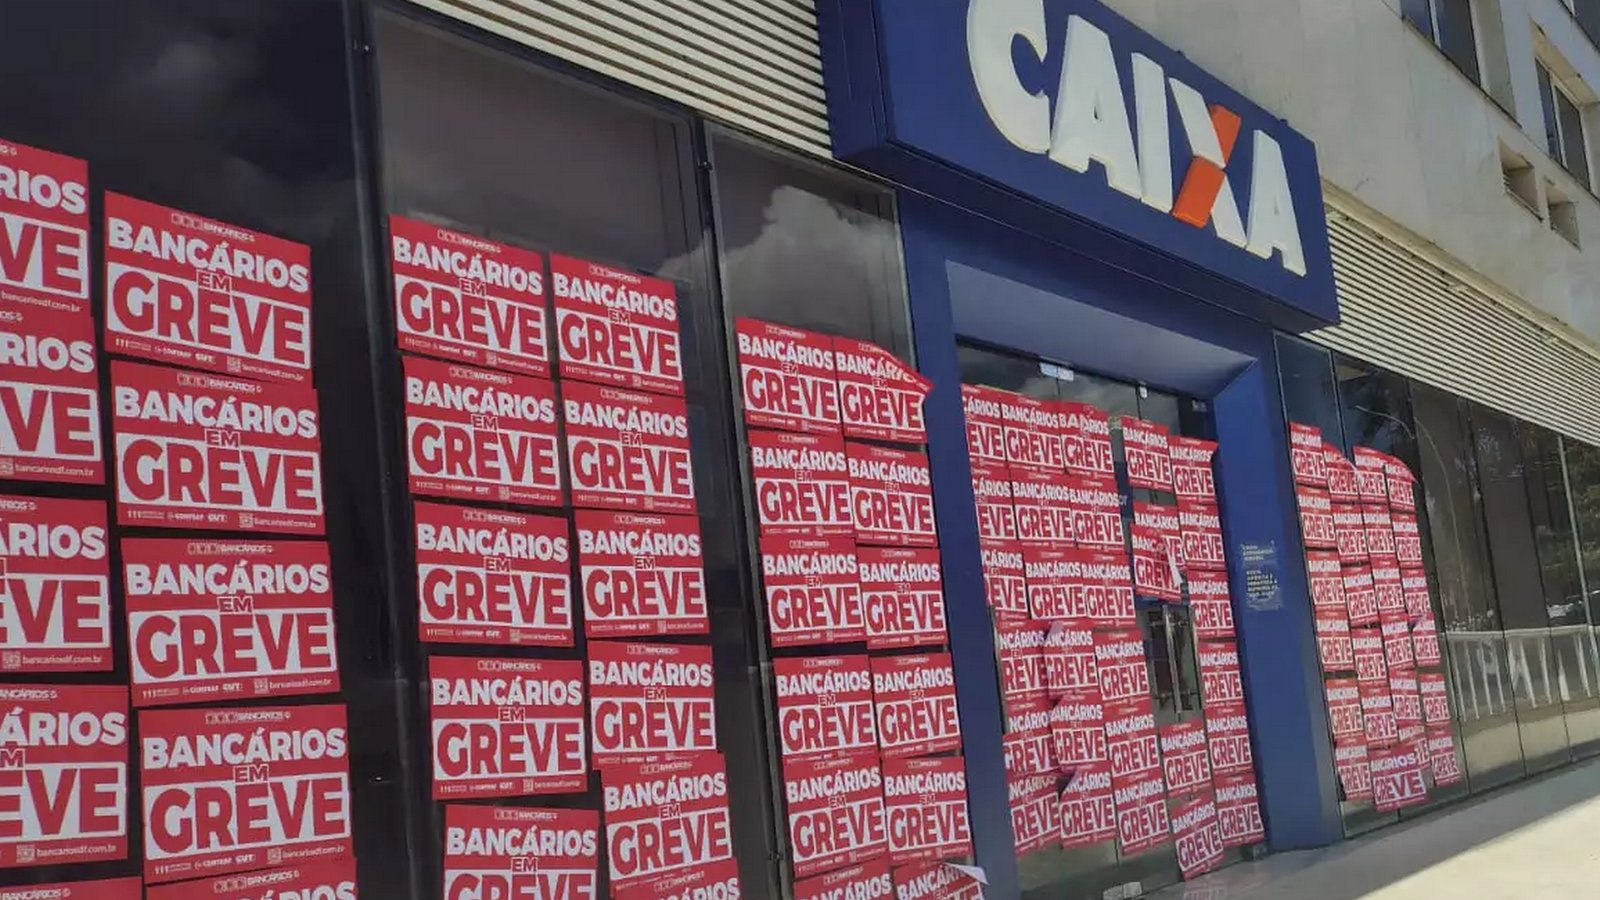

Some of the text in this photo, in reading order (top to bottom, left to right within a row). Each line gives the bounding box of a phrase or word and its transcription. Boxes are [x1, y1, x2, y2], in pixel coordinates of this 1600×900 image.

[966, 0, 1306, 277] CAIXA
[108, 216, 309, 291] BANCÁRIOS
[393, 239, 543, 296] BANCÁRIOS
[196, 270, 231, 294] EM
[459, 280, 484, 299] EM
[554, 273, 676, 320] BANCÁRIOS
[113, 273, 304, 362] GREVE
[400, 284, 542, 356] GREVE
[608, 309, 630, 326] EM
[561, 315, 678, 376] GREVE
[739, 334, 836, 370] BANCÁRIOS
[115, 387, 319, 436] BANCÁRIOS
[406, 380, 556, 424] BANCÁRIOS
[745, 370, 837, 420] GREVE
[842, 385, 923, 428] GREVE
[472, 416, 499, 432] EM
[565, 400, 687, 438] BANCÁRIOS
[1003, 408, 1059, 429] BANCÁRIOS
[204, 429, 239, 448] EM
[412, 424, 557, 484] GREVE
[620, 432, 642, 447] EM
[1007, 431, 1061, 468] GREVE
[122, 440, 317, 509] GREVE
[572, 441, 689, 494] GREVE
[753, 449, 846, 473] BANCÁRIOS
[849, 459, 930, 486] BANCÁRIOS
[1128, 449, 1170, 482] GREVE
[761, 482, 850, 522] GREVE
[1011, 479, 1070, 500] BANCÁRIOS
[854, 491, 933, 531] GREVE
[1017, 506, 1072, 539] GREVE
[1075, 512, 1123, 542] GREVE
[417, 527, 567, 561] BANCÁRIOS
[580, 528, 701, 555] BANCÁRIOS
[126, 560, 329, 595] BANCÁRIOS
[481, 558, 507, 574] EM
[632, 557, 654, 570] EM
[764, 553, 857, 577] BANCÁRIOS
[859, 561, 941, 582] BANCÁRIOS
[1026, 560, 1082, 577] BANCÁRIOS
[0, 578, 103, 643] VE
[217, 597, 253, 614] EM
[423, 569, 567, 624] GREVE
[586, 570, 703, 617] GREVE
[771, 587, 860, 629] GREVE
[1032, 586, 1086, 617] GREVE
[1087, 588, 1135, 616] GREVE
[866, 594, 945, 632] GREVE
[136, 612, 331, 678] GREVE
[432, 676, 583, 705] BANCÁRIOS
[590, 660, 710, 687] BANCÁRIOS
[777, 670, 872, 697] BANCÁRIOS
[874, 670, 953, 696] BANCÁRIOS
[1102, 665, 1147, 697] GREVE
[643, 688, 664, 701] EM
[497, 707, 523, 722] EM
[595, 701, 712, 749] GREVE
[783, 704, 874, 751] GREVE
[880, 699, 957, 743] GREVE
[142, 729, 344, 771] BANCÁRIOS
[437, 722, 581, 775] GREVE
[1056, 730, 1106, 762] GREVE
[1112, 738, 1158, 775] GREVE
[232, 766, 267, 785] EM
[785, 769, 882, 802] BANCÁRIOS
[886, 774, 964, 799] BANCÁRIOS
[1167, 753, 1209, 788] GREVE
[603, 774, 726, 812] BANCÁRIOS
[150, 778, 344, 852] GREVE
[658, 805, 679, 820] EM
[794, 802, 884, 857] GREVE
[890, 804, 968, 847] GREVE
[1062, 797, 1114, 835] GREVE
[1121, 803, 1167, 842] GREVE
[444, 827, 594, 857] BANCÁRIOS
[611, 812, 728, 874] GREVE
[1179, 824, 1222, 867] GREVE
[509, 859, 535, 873] EM
